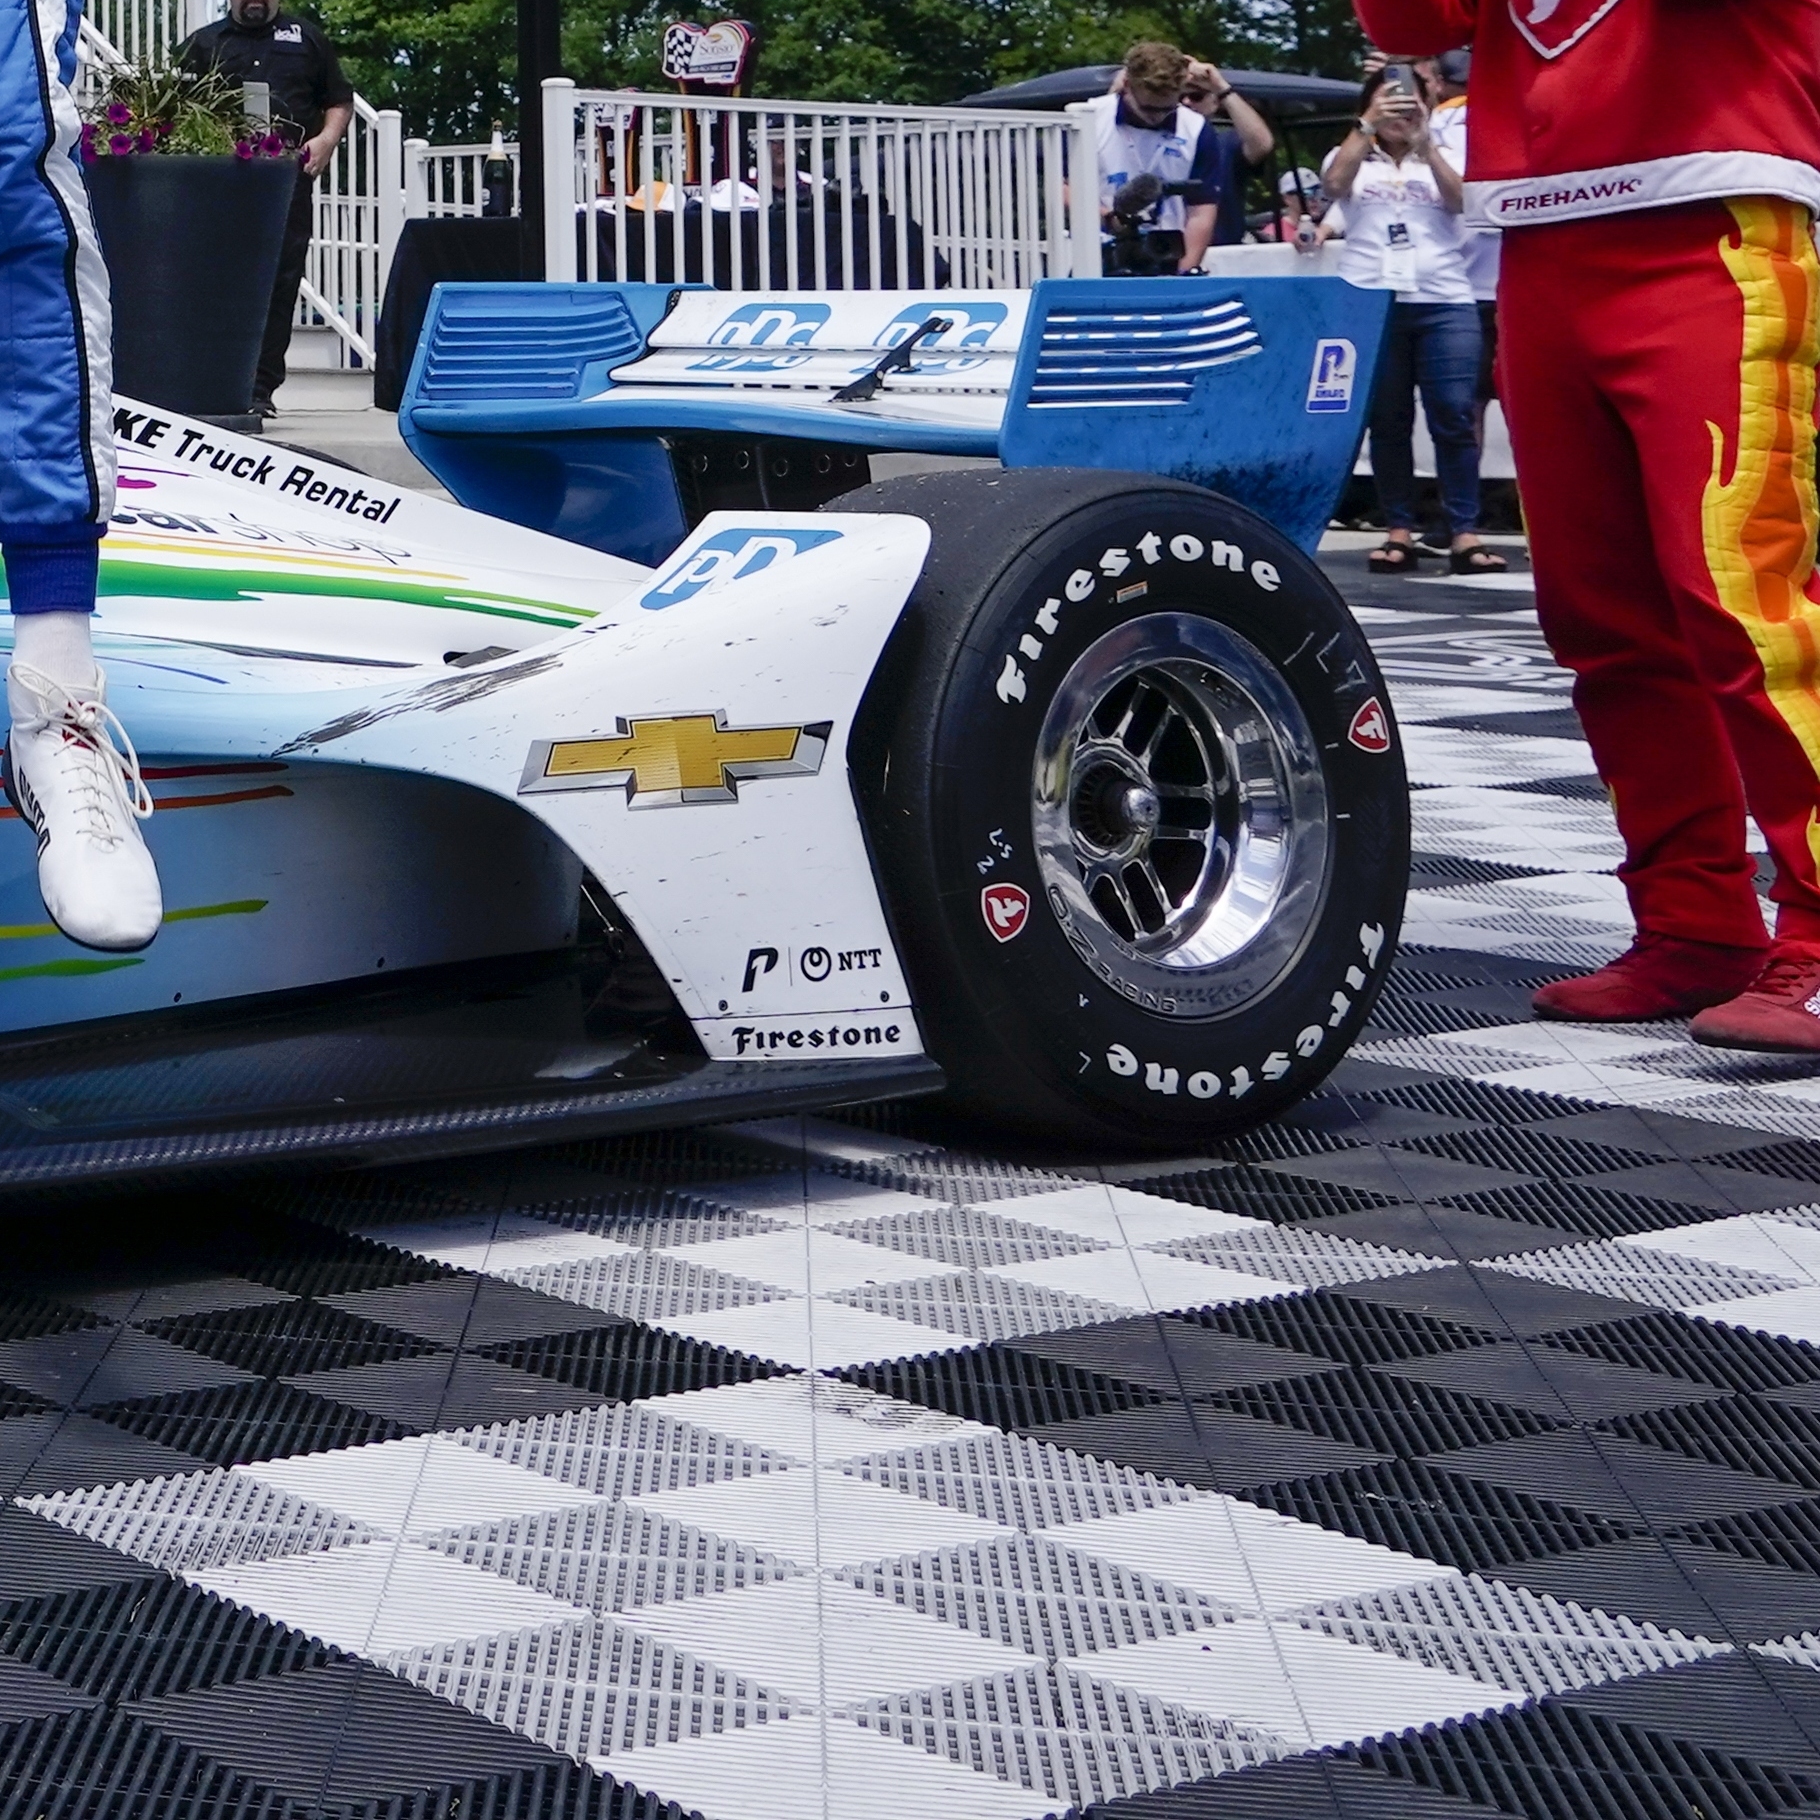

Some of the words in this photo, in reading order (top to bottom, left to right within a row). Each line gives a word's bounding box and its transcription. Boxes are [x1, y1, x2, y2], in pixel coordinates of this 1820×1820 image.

[1500, 182, 1637, 213] FIREHAWK
[173, 428, 276, 484] Truck
[281, 465, 402, 525] Rental
[996, 529, 1281, 707] Firestone
[838, 949, 882, 971] NTT
[731, 1021, 902, 1055] Firestone
[1106, 920, 1387, 1101] Firestone
